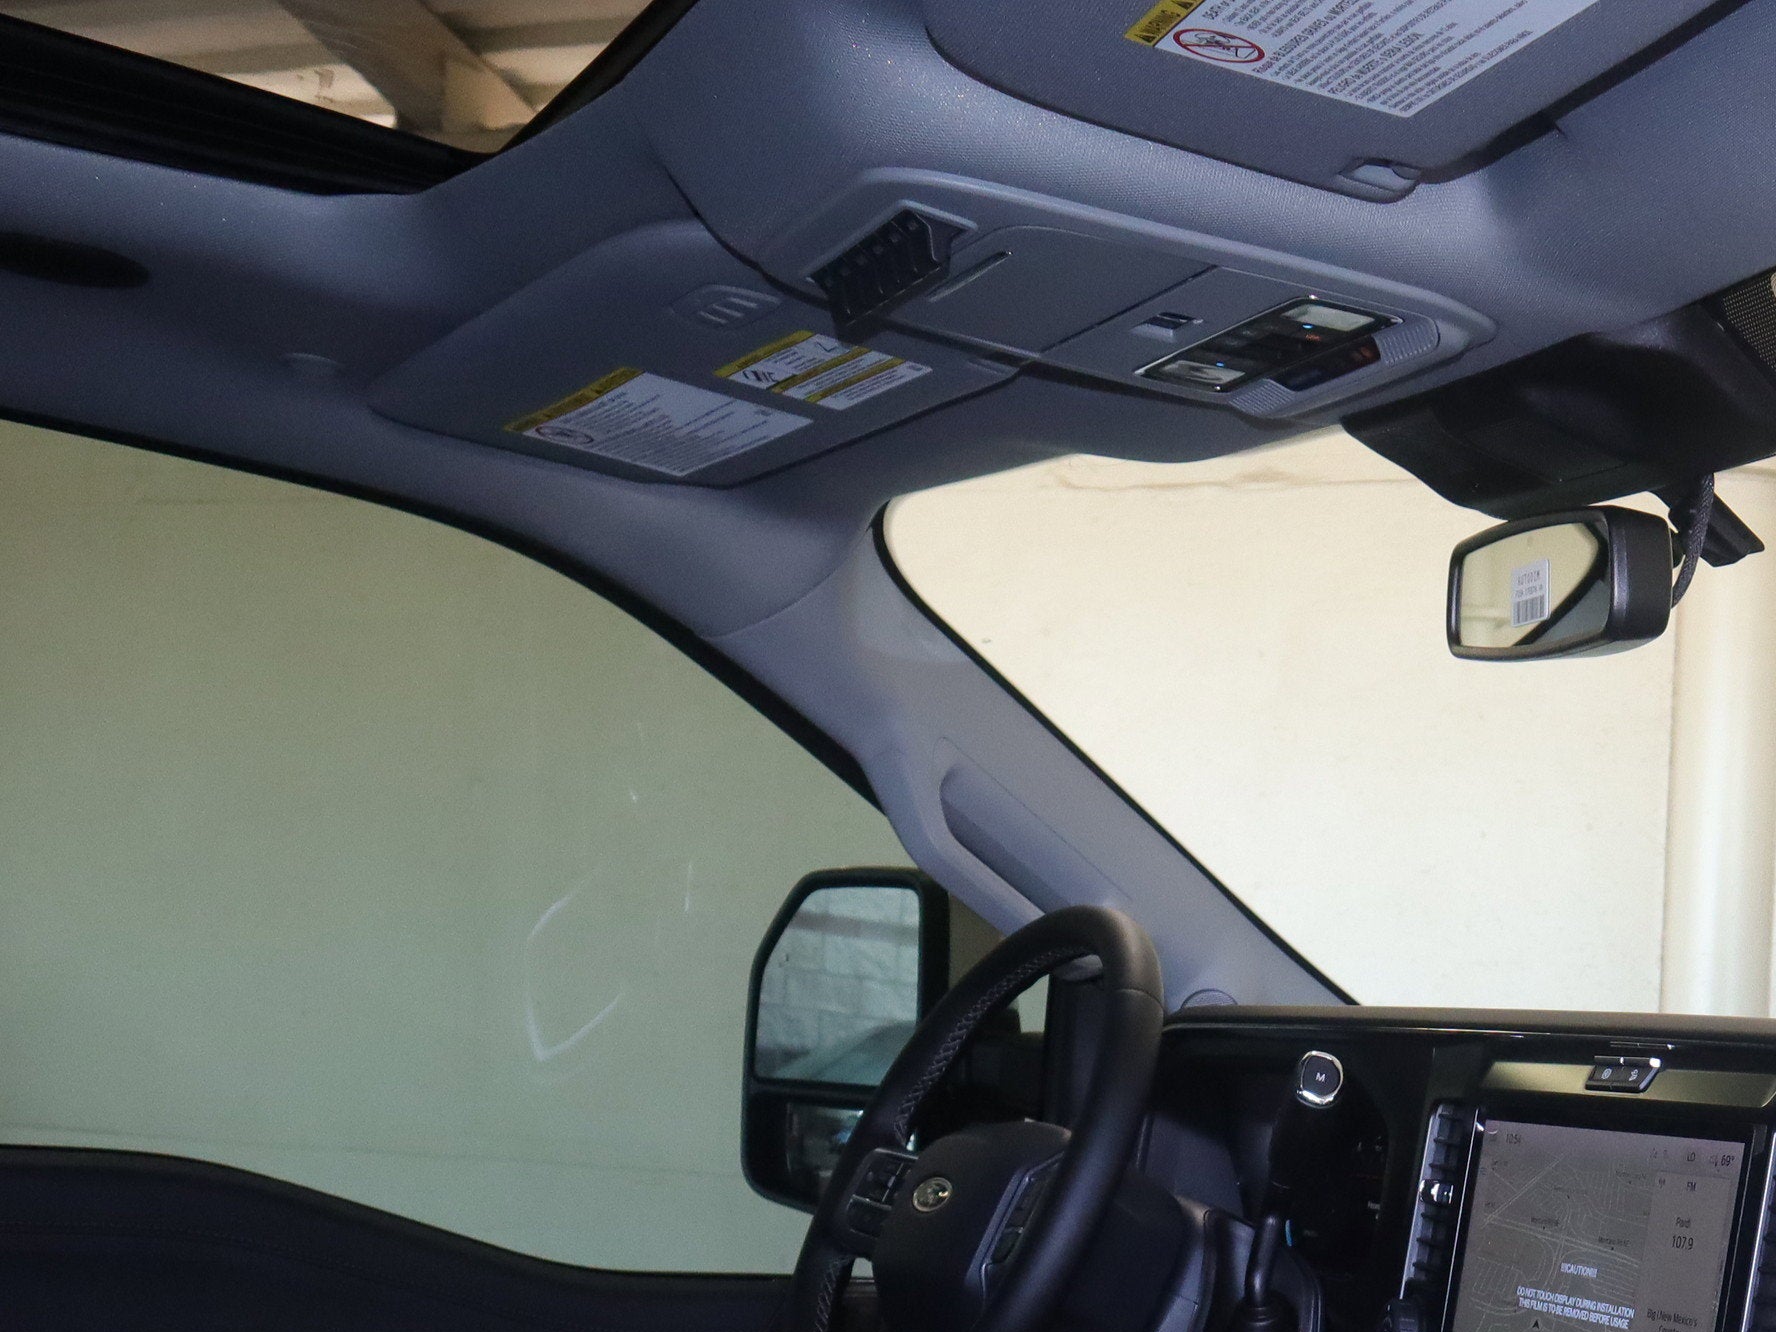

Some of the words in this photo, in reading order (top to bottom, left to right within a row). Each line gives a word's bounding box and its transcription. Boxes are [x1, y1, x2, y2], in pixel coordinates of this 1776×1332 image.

[1314, 1072, 1327, 1083] M
[1686, 1181, 1697, 1192] FM
[1672, 1235, 1694, 1250] 107.9
[1525, 1287, 1536, 1298] NOT
[1537, 1289, 1555, 1301] TOUCH
[1555, 1293, 1577, 1306] DISPLAY
[1576, 1297, 1597, 1311] DURING
[1597, 1302, 1635, 1318] INSTALLATION
[1519, 1297, 1531, 1309] THIS
[1531, 1299, 1543, 1312] FILM
[1564, 1306, 1589, 1321] REMOVED
[1589, 1311, 1610, 1325] BEFORE
[1610, 1316, 1630, 1330] USAGE
[1647, 1308, 1656, 1321] Big
[1660, 1311, 1673, 1322] New
